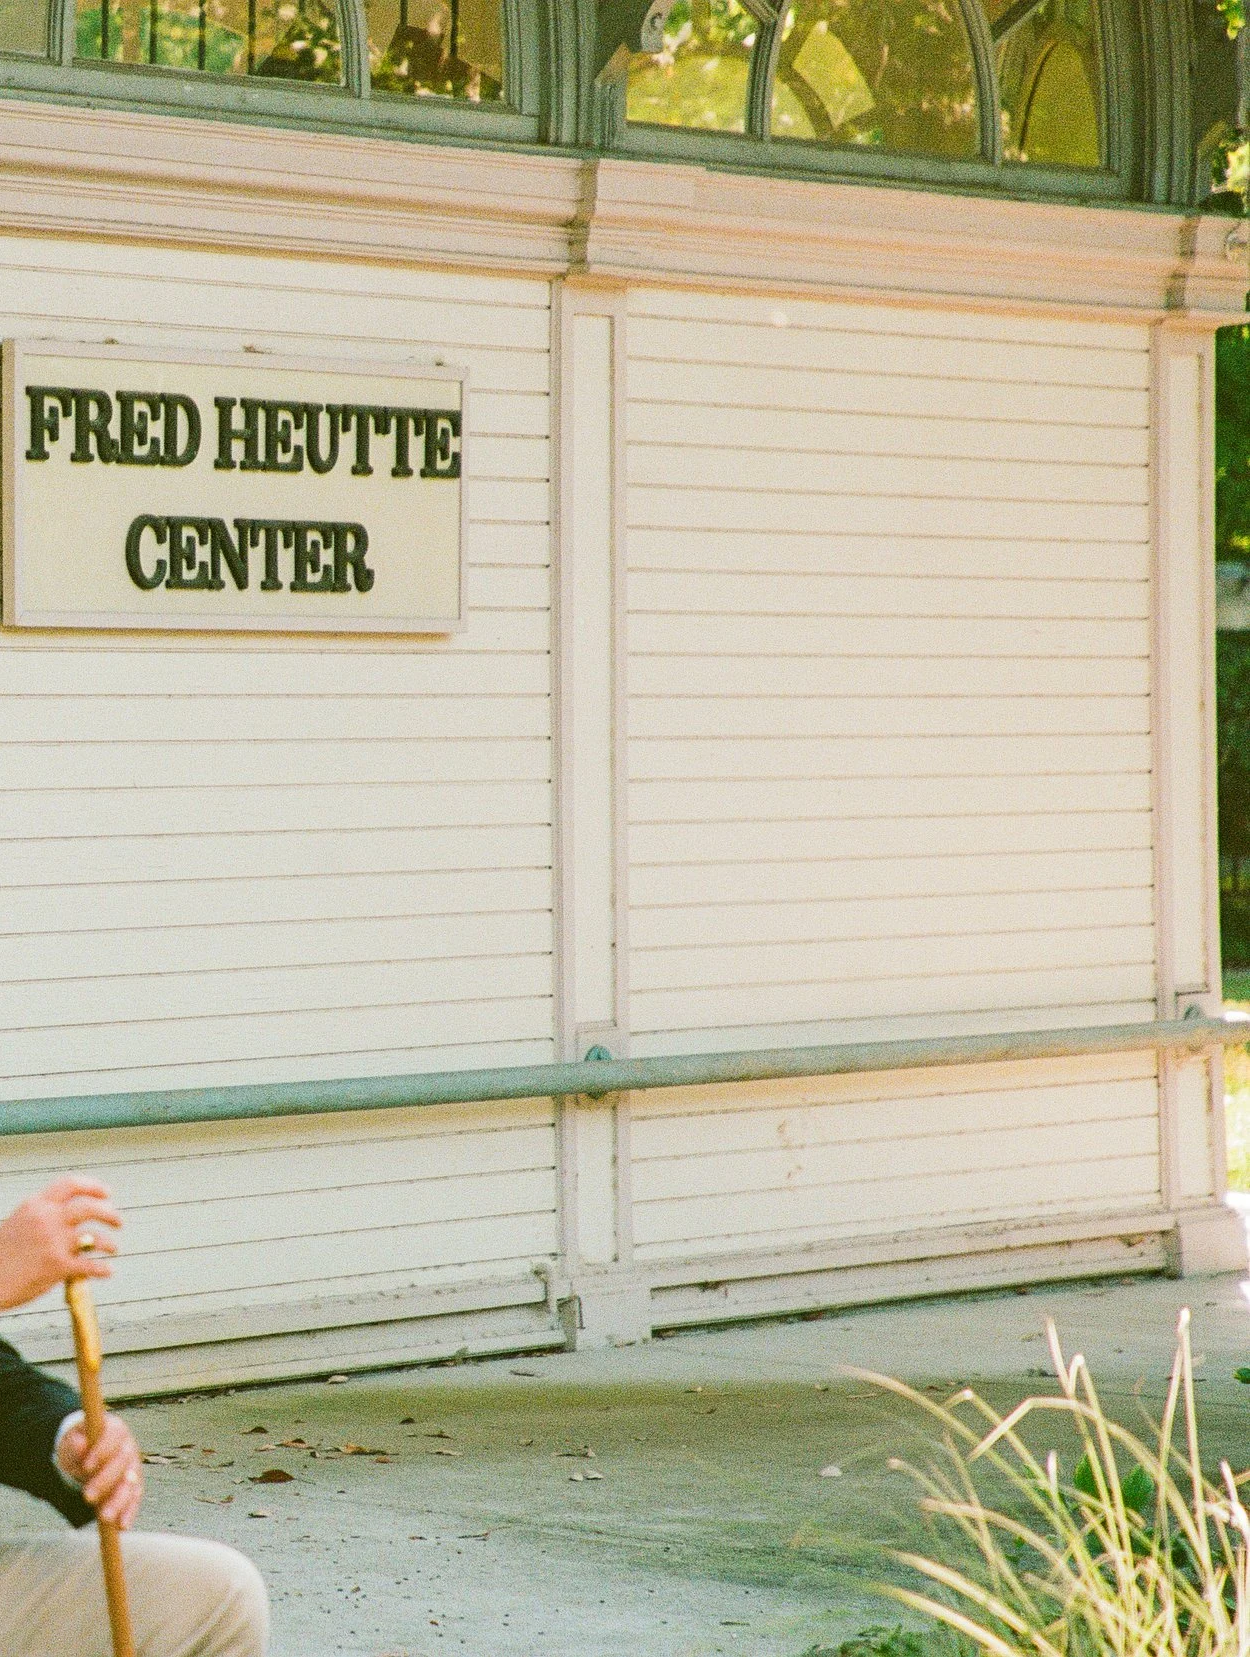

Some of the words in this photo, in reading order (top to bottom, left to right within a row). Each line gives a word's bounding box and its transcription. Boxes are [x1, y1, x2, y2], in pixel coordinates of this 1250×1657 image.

[25, 385, 202, 467] FRED
[213, 396, 462, 479] HEUTTE
[125, 514, 375, 593] CENTER
